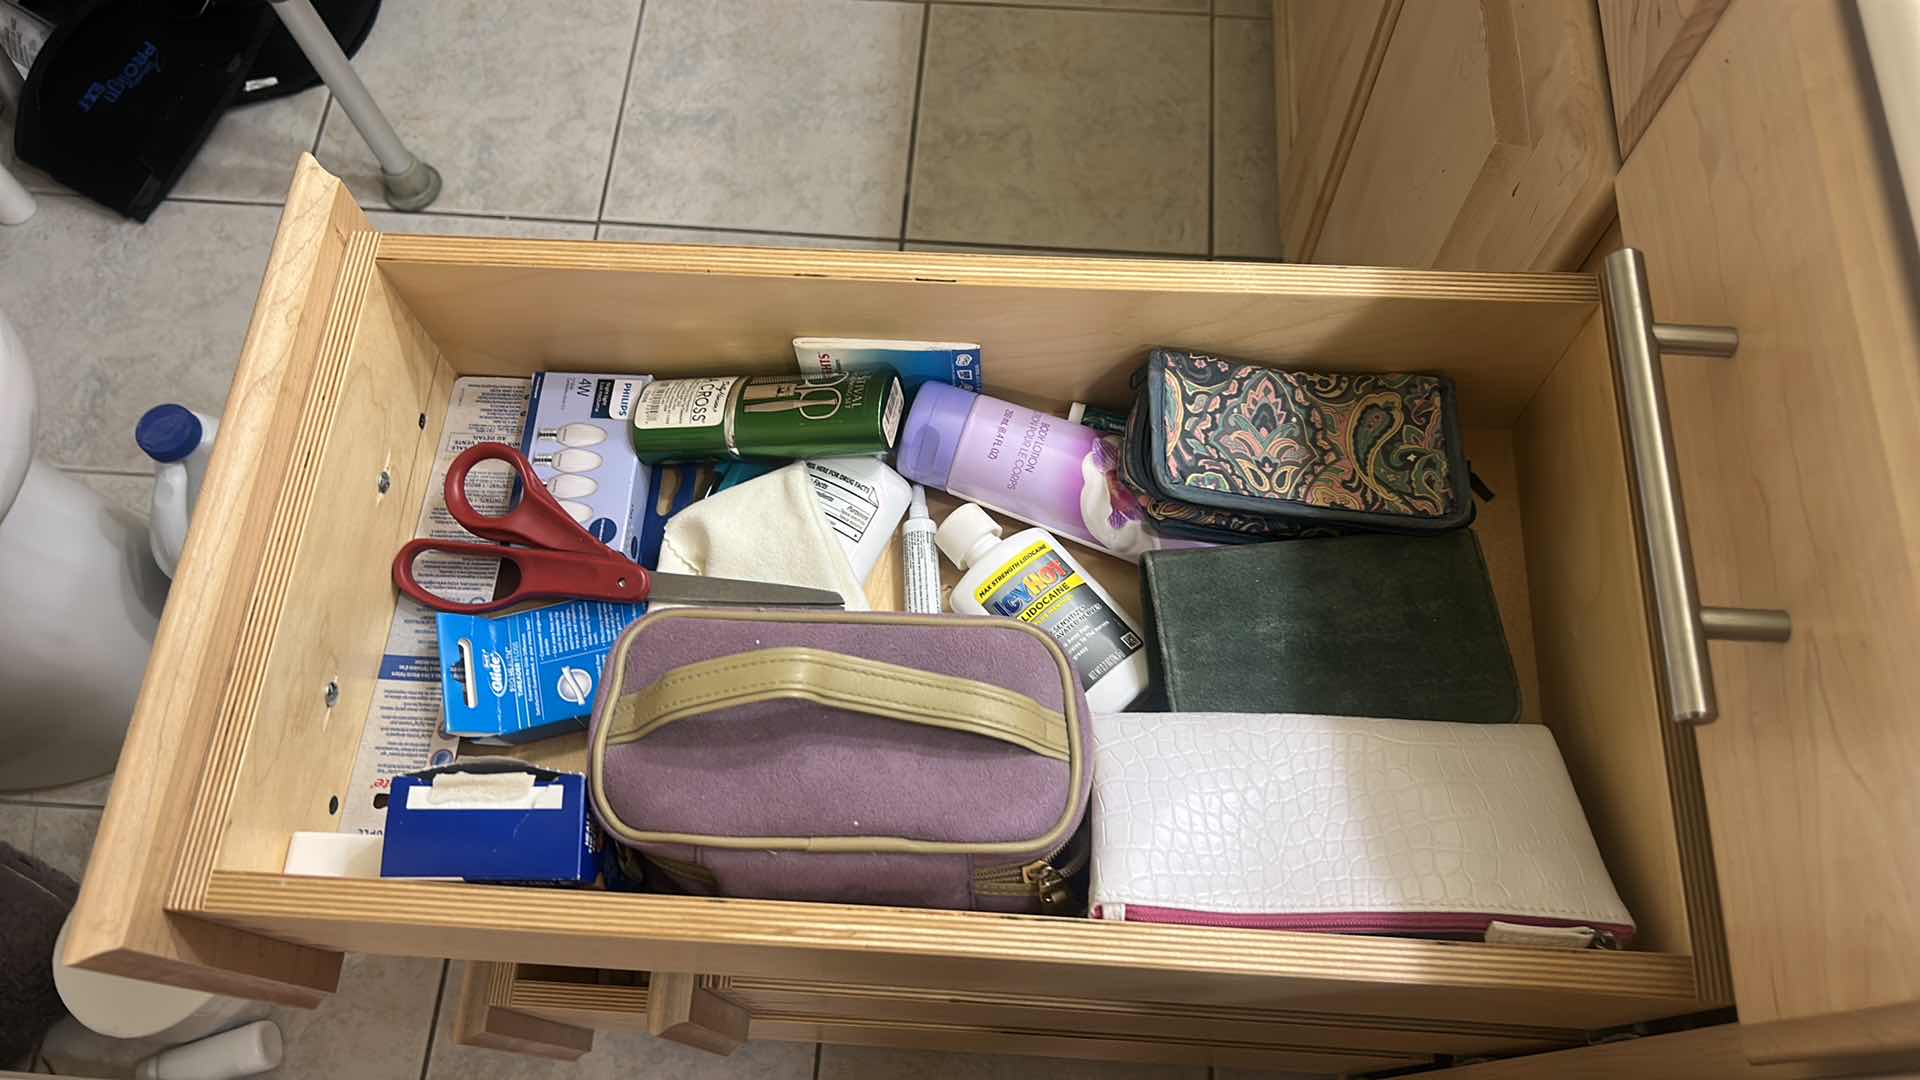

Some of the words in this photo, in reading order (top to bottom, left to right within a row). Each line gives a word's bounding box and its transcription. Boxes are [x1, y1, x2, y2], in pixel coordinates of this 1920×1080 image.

[577, 378, 592, 396] 4W
[618, 382, 631, 416] PHILIPS
[691, 384, 714, 422] CROSS
[1036, 422, 1050, 441] BODY
[1017, 448, 1027, 458] LE
[1024, 441, 1043, 472] LOTION
[828, 469, 840, 477] FOR
[839, 473, 854, 485] DRUG
[1007, 459, 1023, 489] CORPS
[978, 584, 992, 598] MAX
[991, 562, 1021, 586] STRENGTH
[1019, 542, 1047, 564] LIDOCAINE
[1021, 581, 1070, 622] LIDOCAINE
[491, 656, 501, 691] Glide
[513, 662, 523, 696] THREADER
